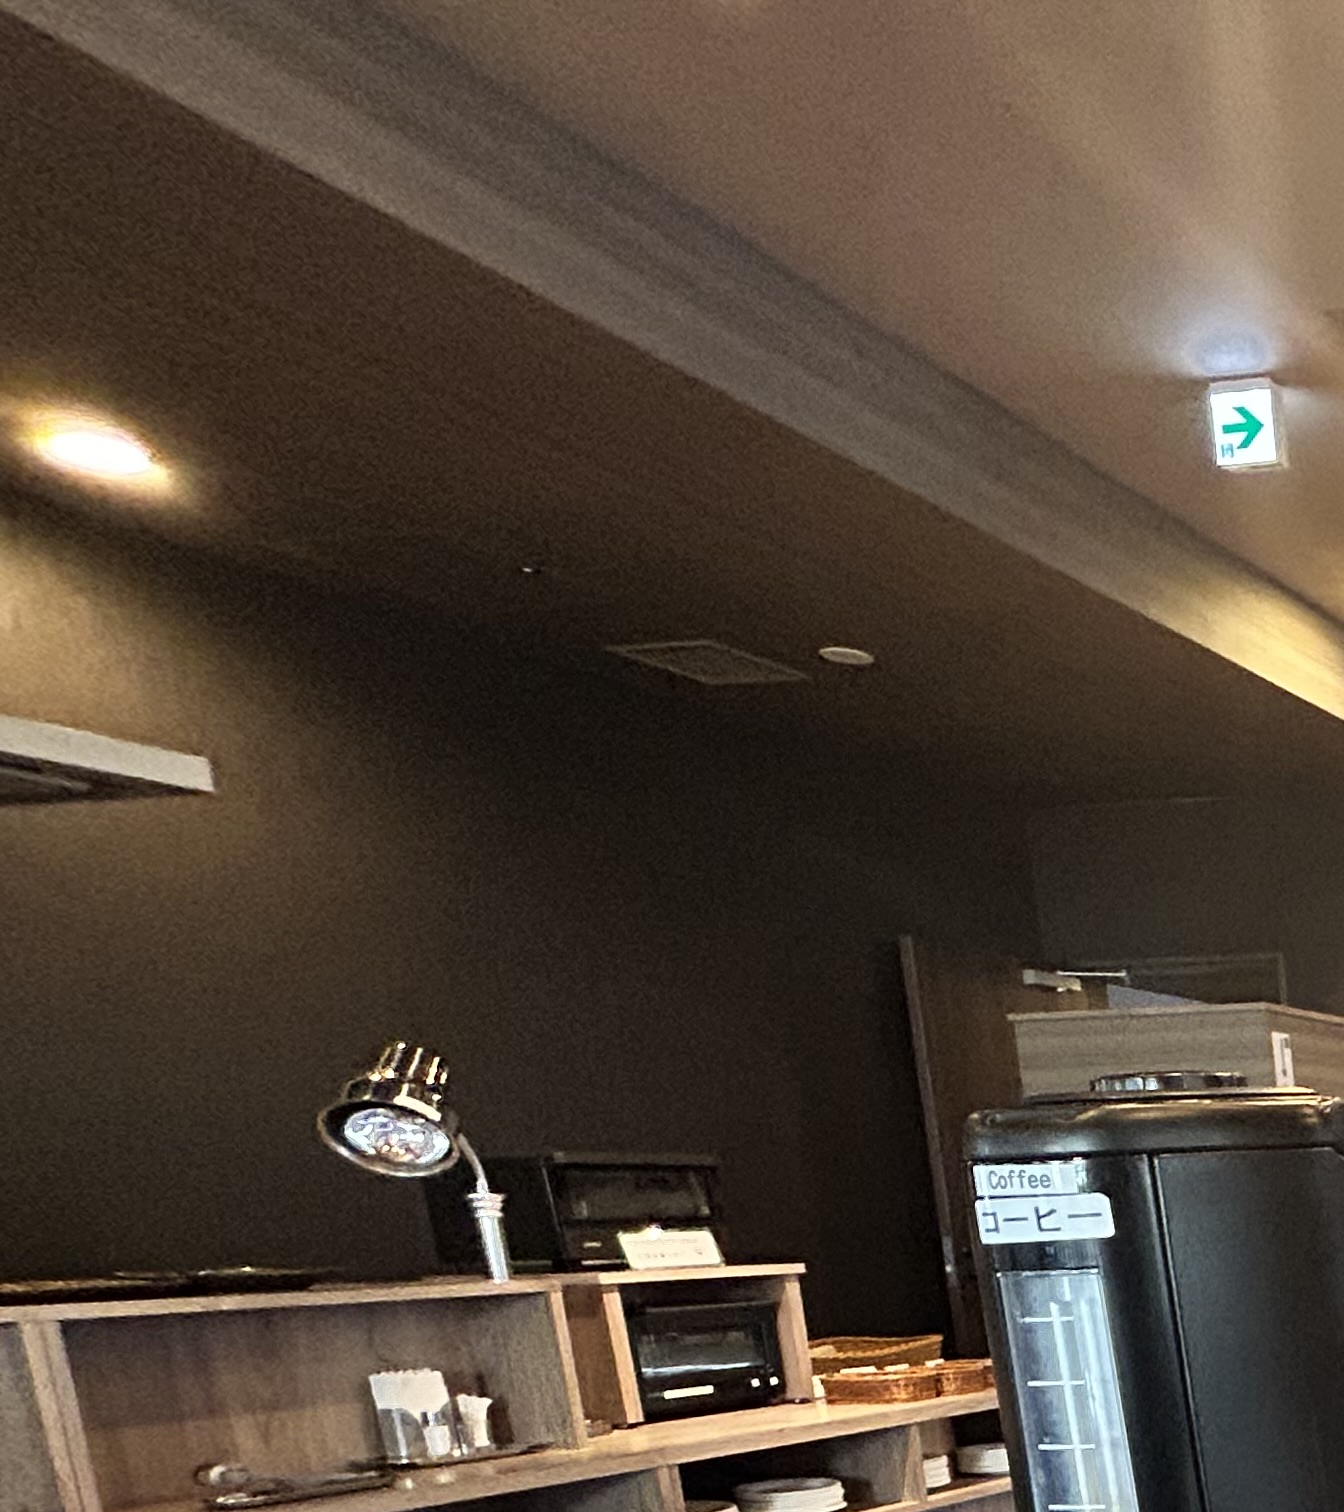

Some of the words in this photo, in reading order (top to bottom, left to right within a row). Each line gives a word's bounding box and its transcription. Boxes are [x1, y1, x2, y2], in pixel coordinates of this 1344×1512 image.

[987, 1169, 1052, 1190] Coffee
[981, 1206, 1103, 1234] コーヒー
